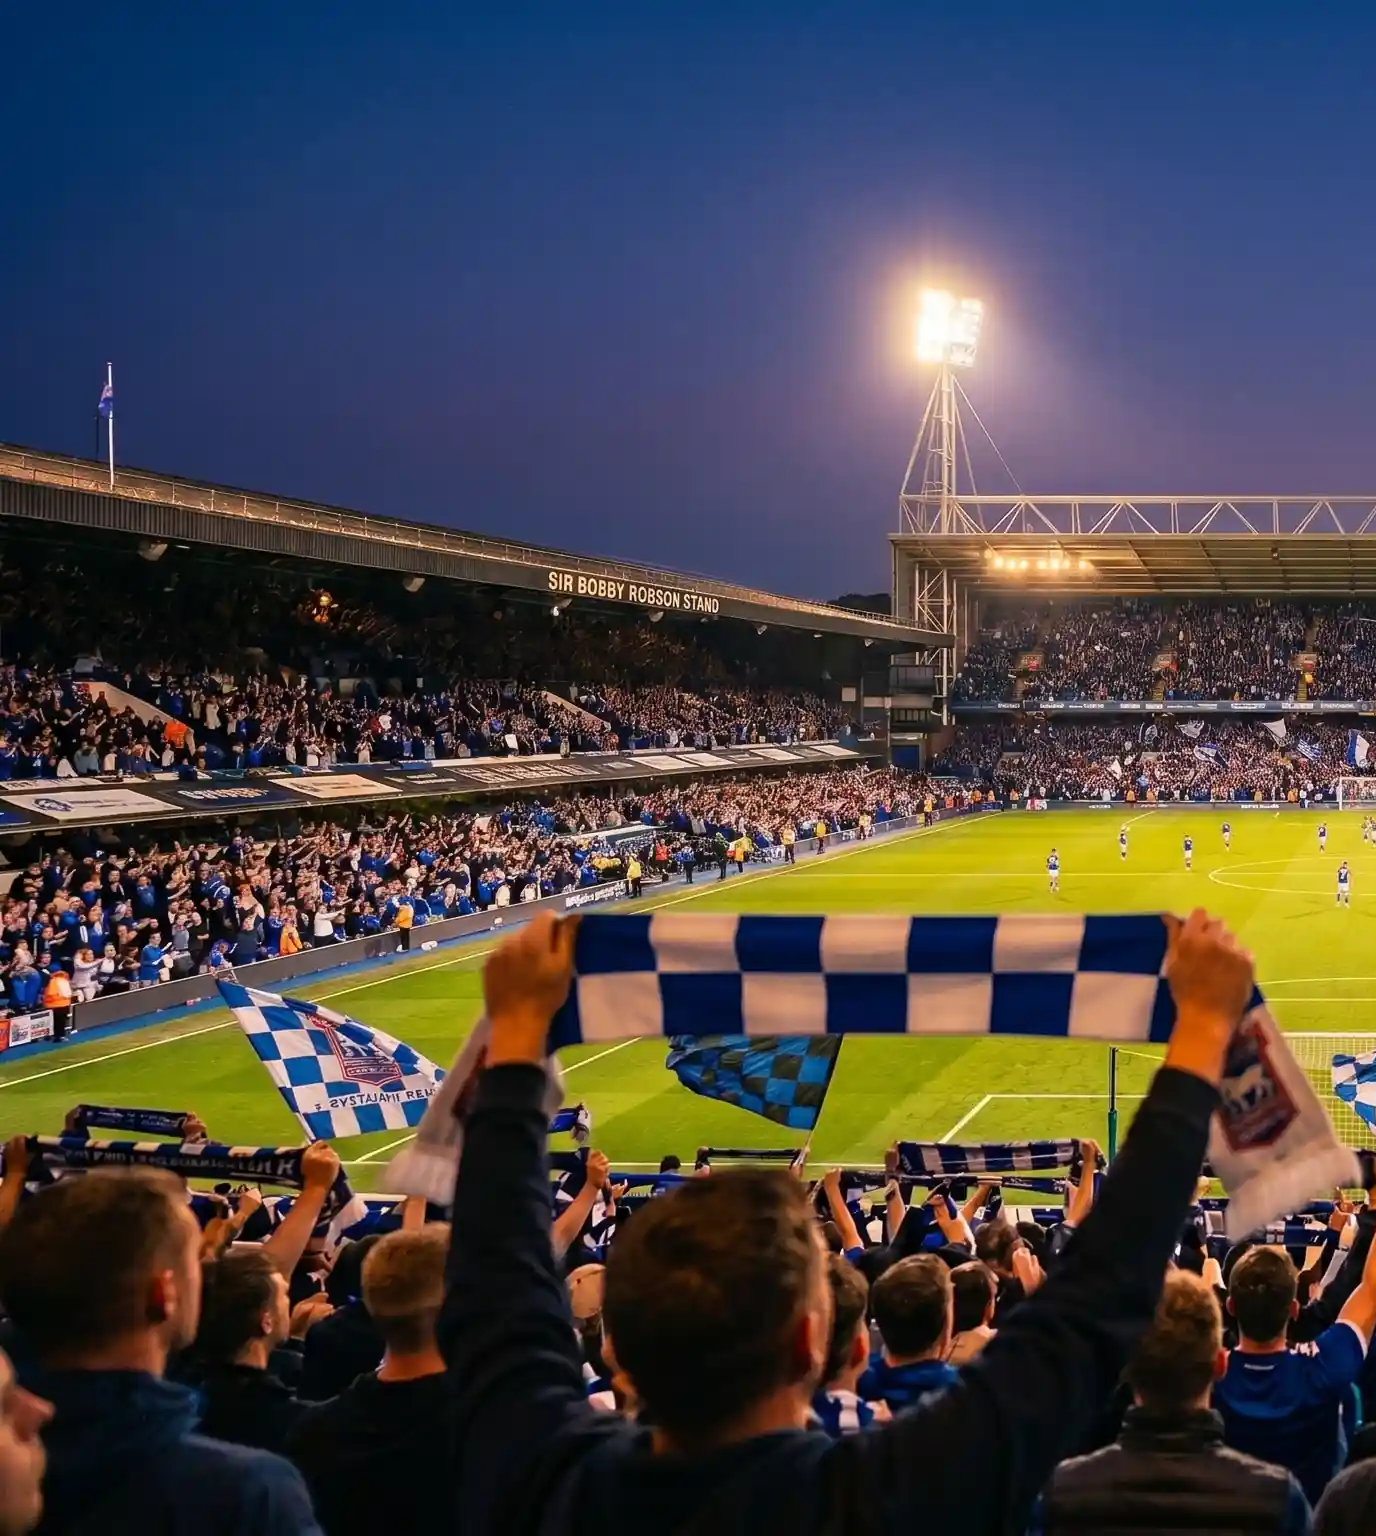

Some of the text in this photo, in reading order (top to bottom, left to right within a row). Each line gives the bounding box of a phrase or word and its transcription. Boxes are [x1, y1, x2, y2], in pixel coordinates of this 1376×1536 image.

[549, 571, 720, 614] SIR BOBBY ROBSON STAND
